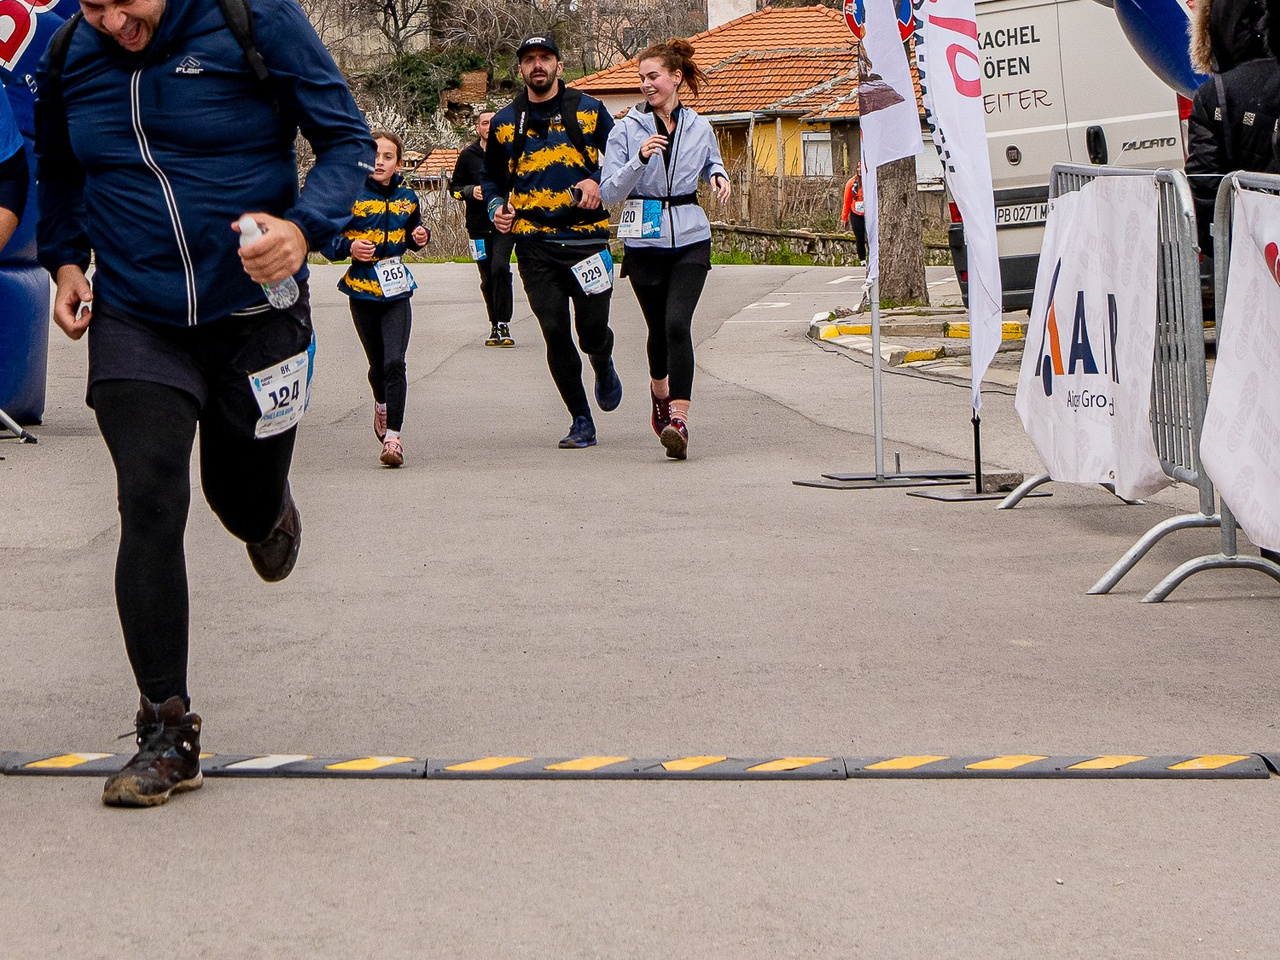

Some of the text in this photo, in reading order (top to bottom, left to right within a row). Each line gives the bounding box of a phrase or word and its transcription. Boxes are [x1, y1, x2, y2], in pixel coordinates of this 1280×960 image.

[983, 55, 1031, 79] ÖFEN
[1122, 136, 1177, 152] DUCATO
[1013, 205, 1038, 221] 0271
[382, 267, 403, 282] 265
[581, 266, 602, 283] 229
[268, 380, 299, 411] 124
